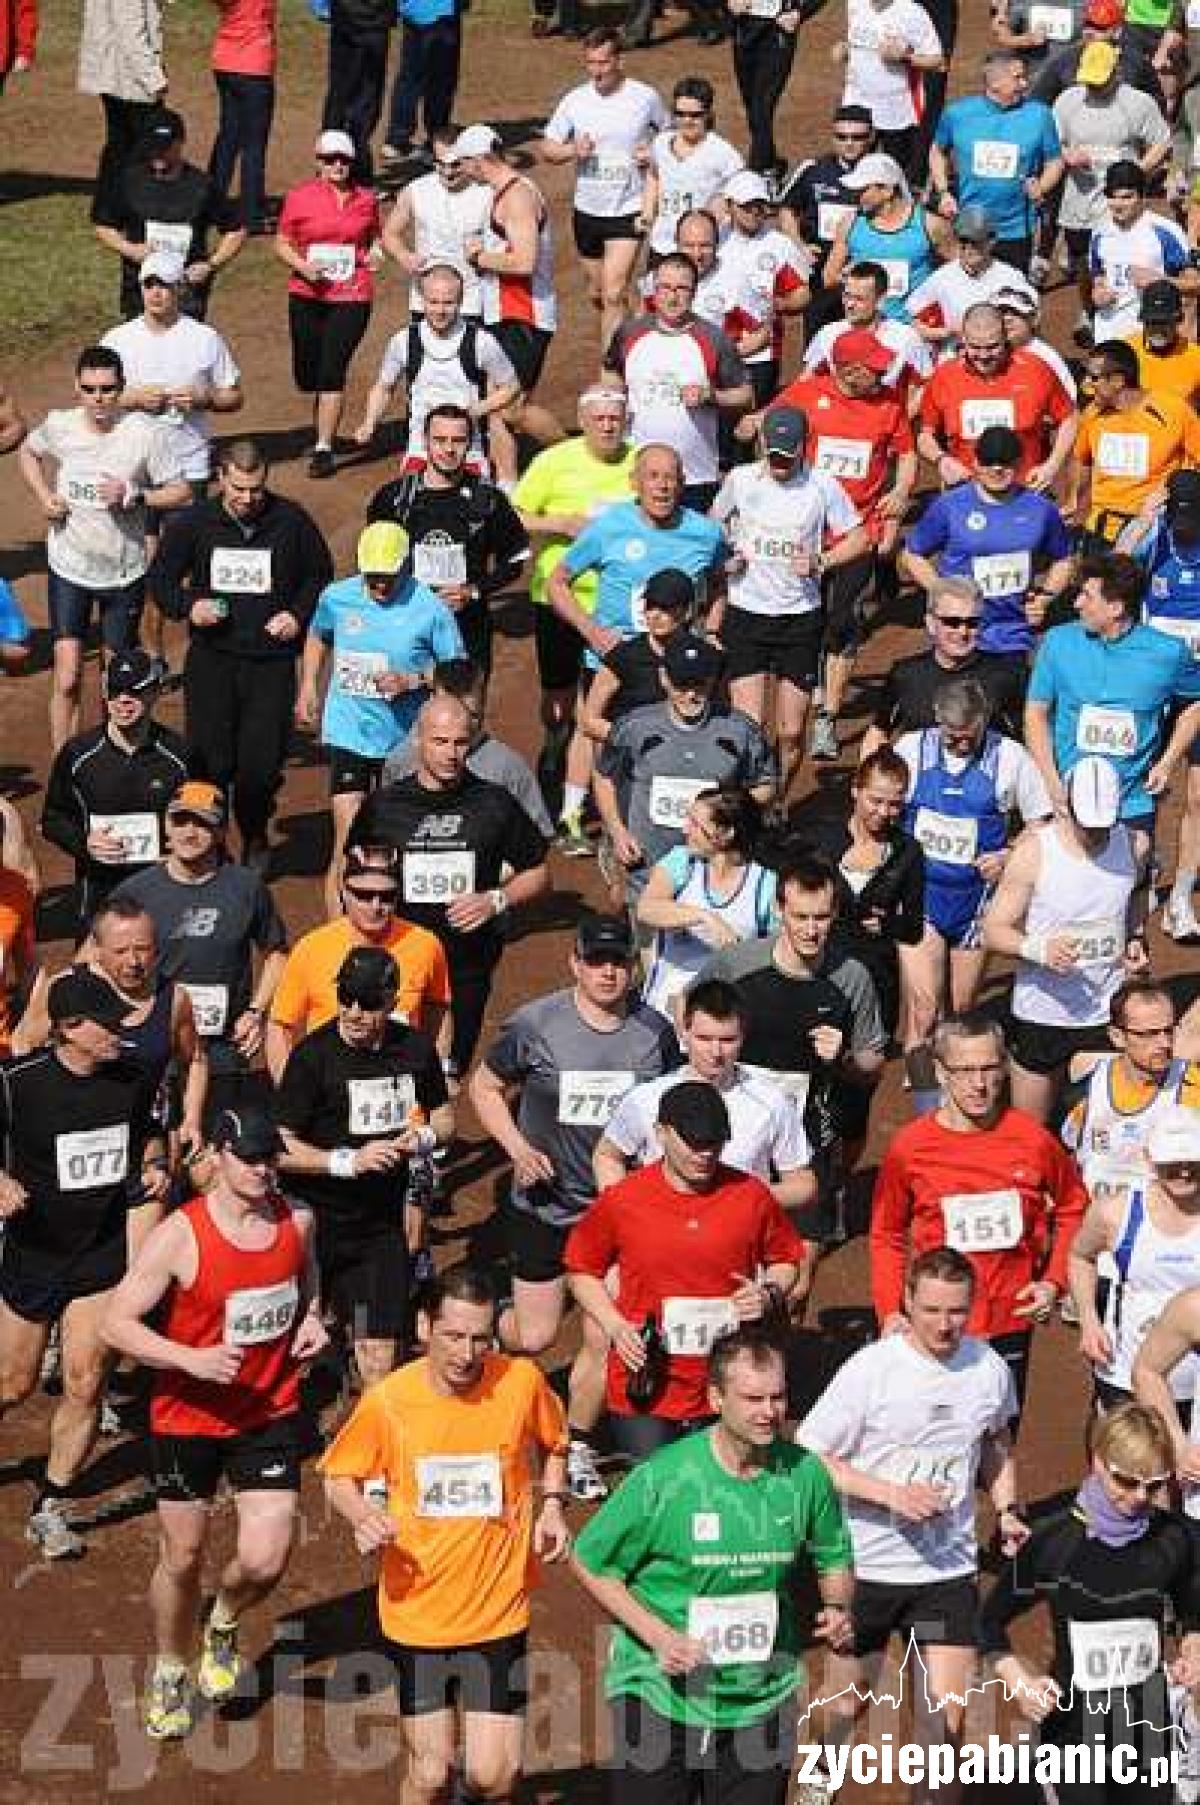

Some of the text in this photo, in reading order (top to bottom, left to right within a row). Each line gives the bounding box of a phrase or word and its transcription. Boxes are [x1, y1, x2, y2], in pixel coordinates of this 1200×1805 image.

[410, 873, 467, 895] 390
[66, 1147, 119, 1176] 077
[952, 1211, 1012, 1243] 151
[423, 1479, 493, 1507] 454
